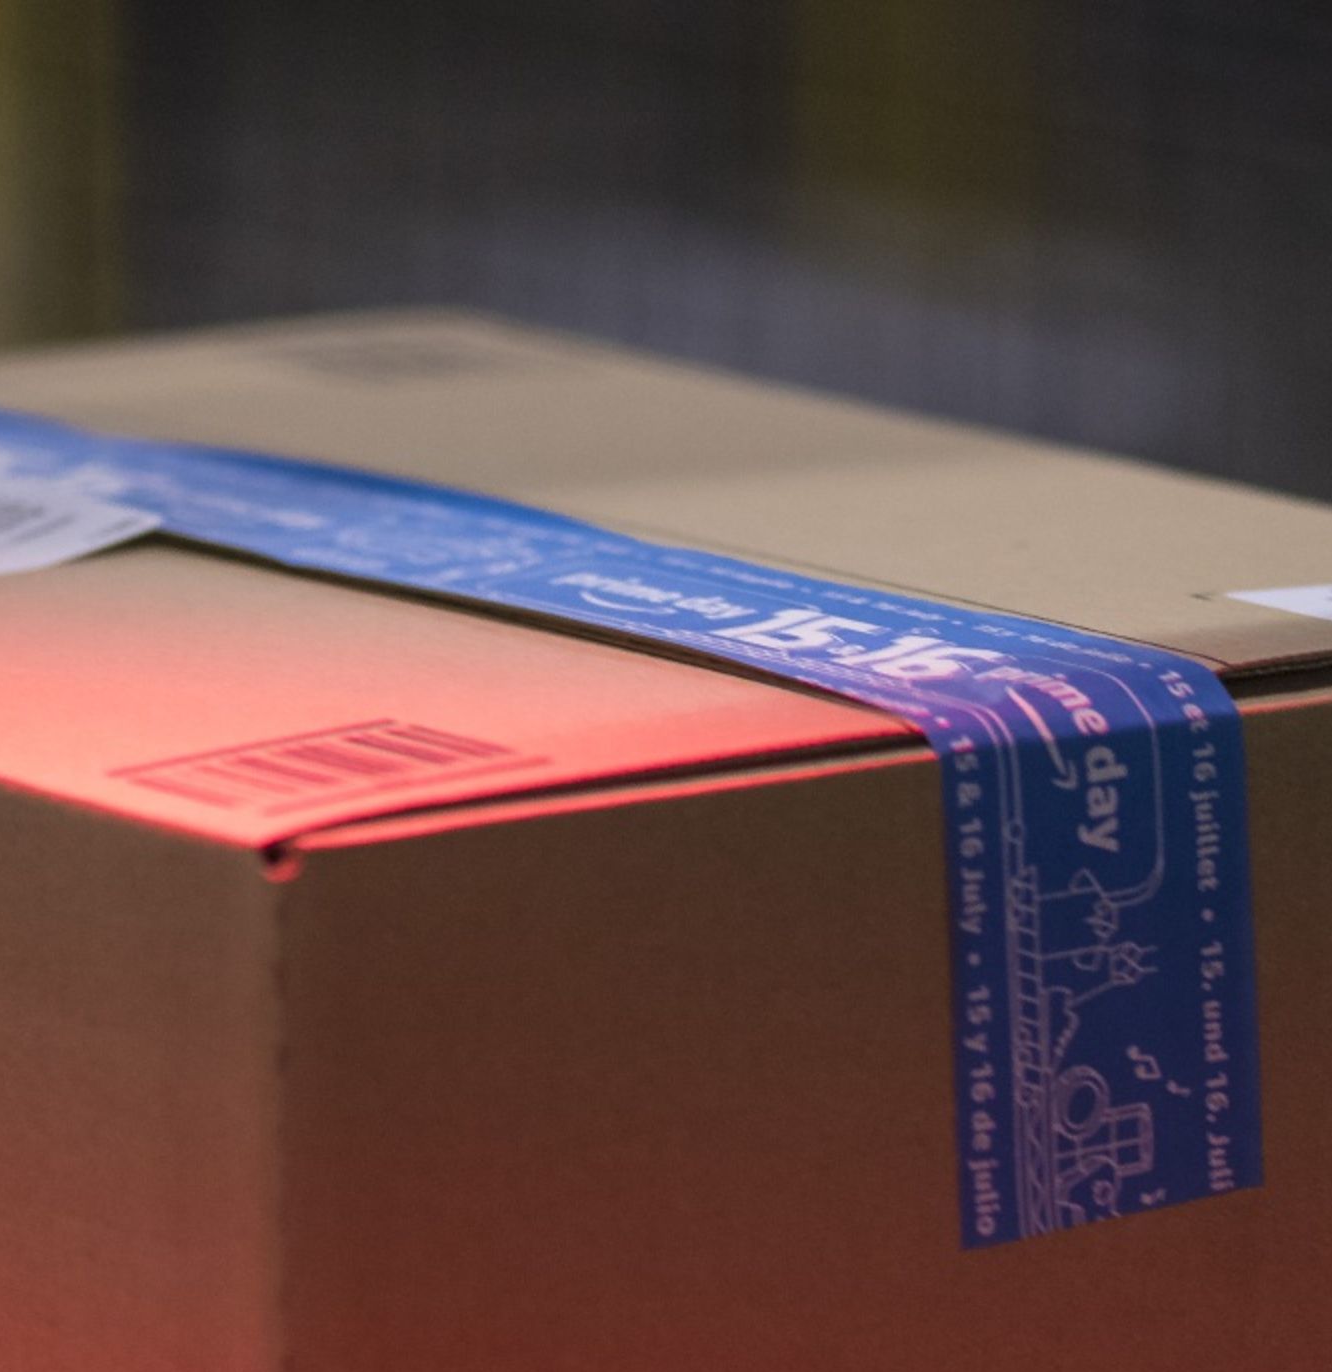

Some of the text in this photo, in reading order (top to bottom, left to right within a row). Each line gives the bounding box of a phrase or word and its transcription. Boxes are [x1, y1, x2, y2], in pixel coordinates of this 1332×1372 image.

[708, 608, 889, 650] 15
[831, 634, 1007, 681] 16
[949, 735, 980, 772] 15
[1157, 669, 1222, 891] 15 et 16 juillet
[959, 817, 984, 858] 16
[1077, 745, 1129, 853] day
[958, 867, 988, 935] July
[963, 984, 1003, 1237] 15 y 16 de julio
[1199, 940, 1236, 1191] 15. und 16. Juli
